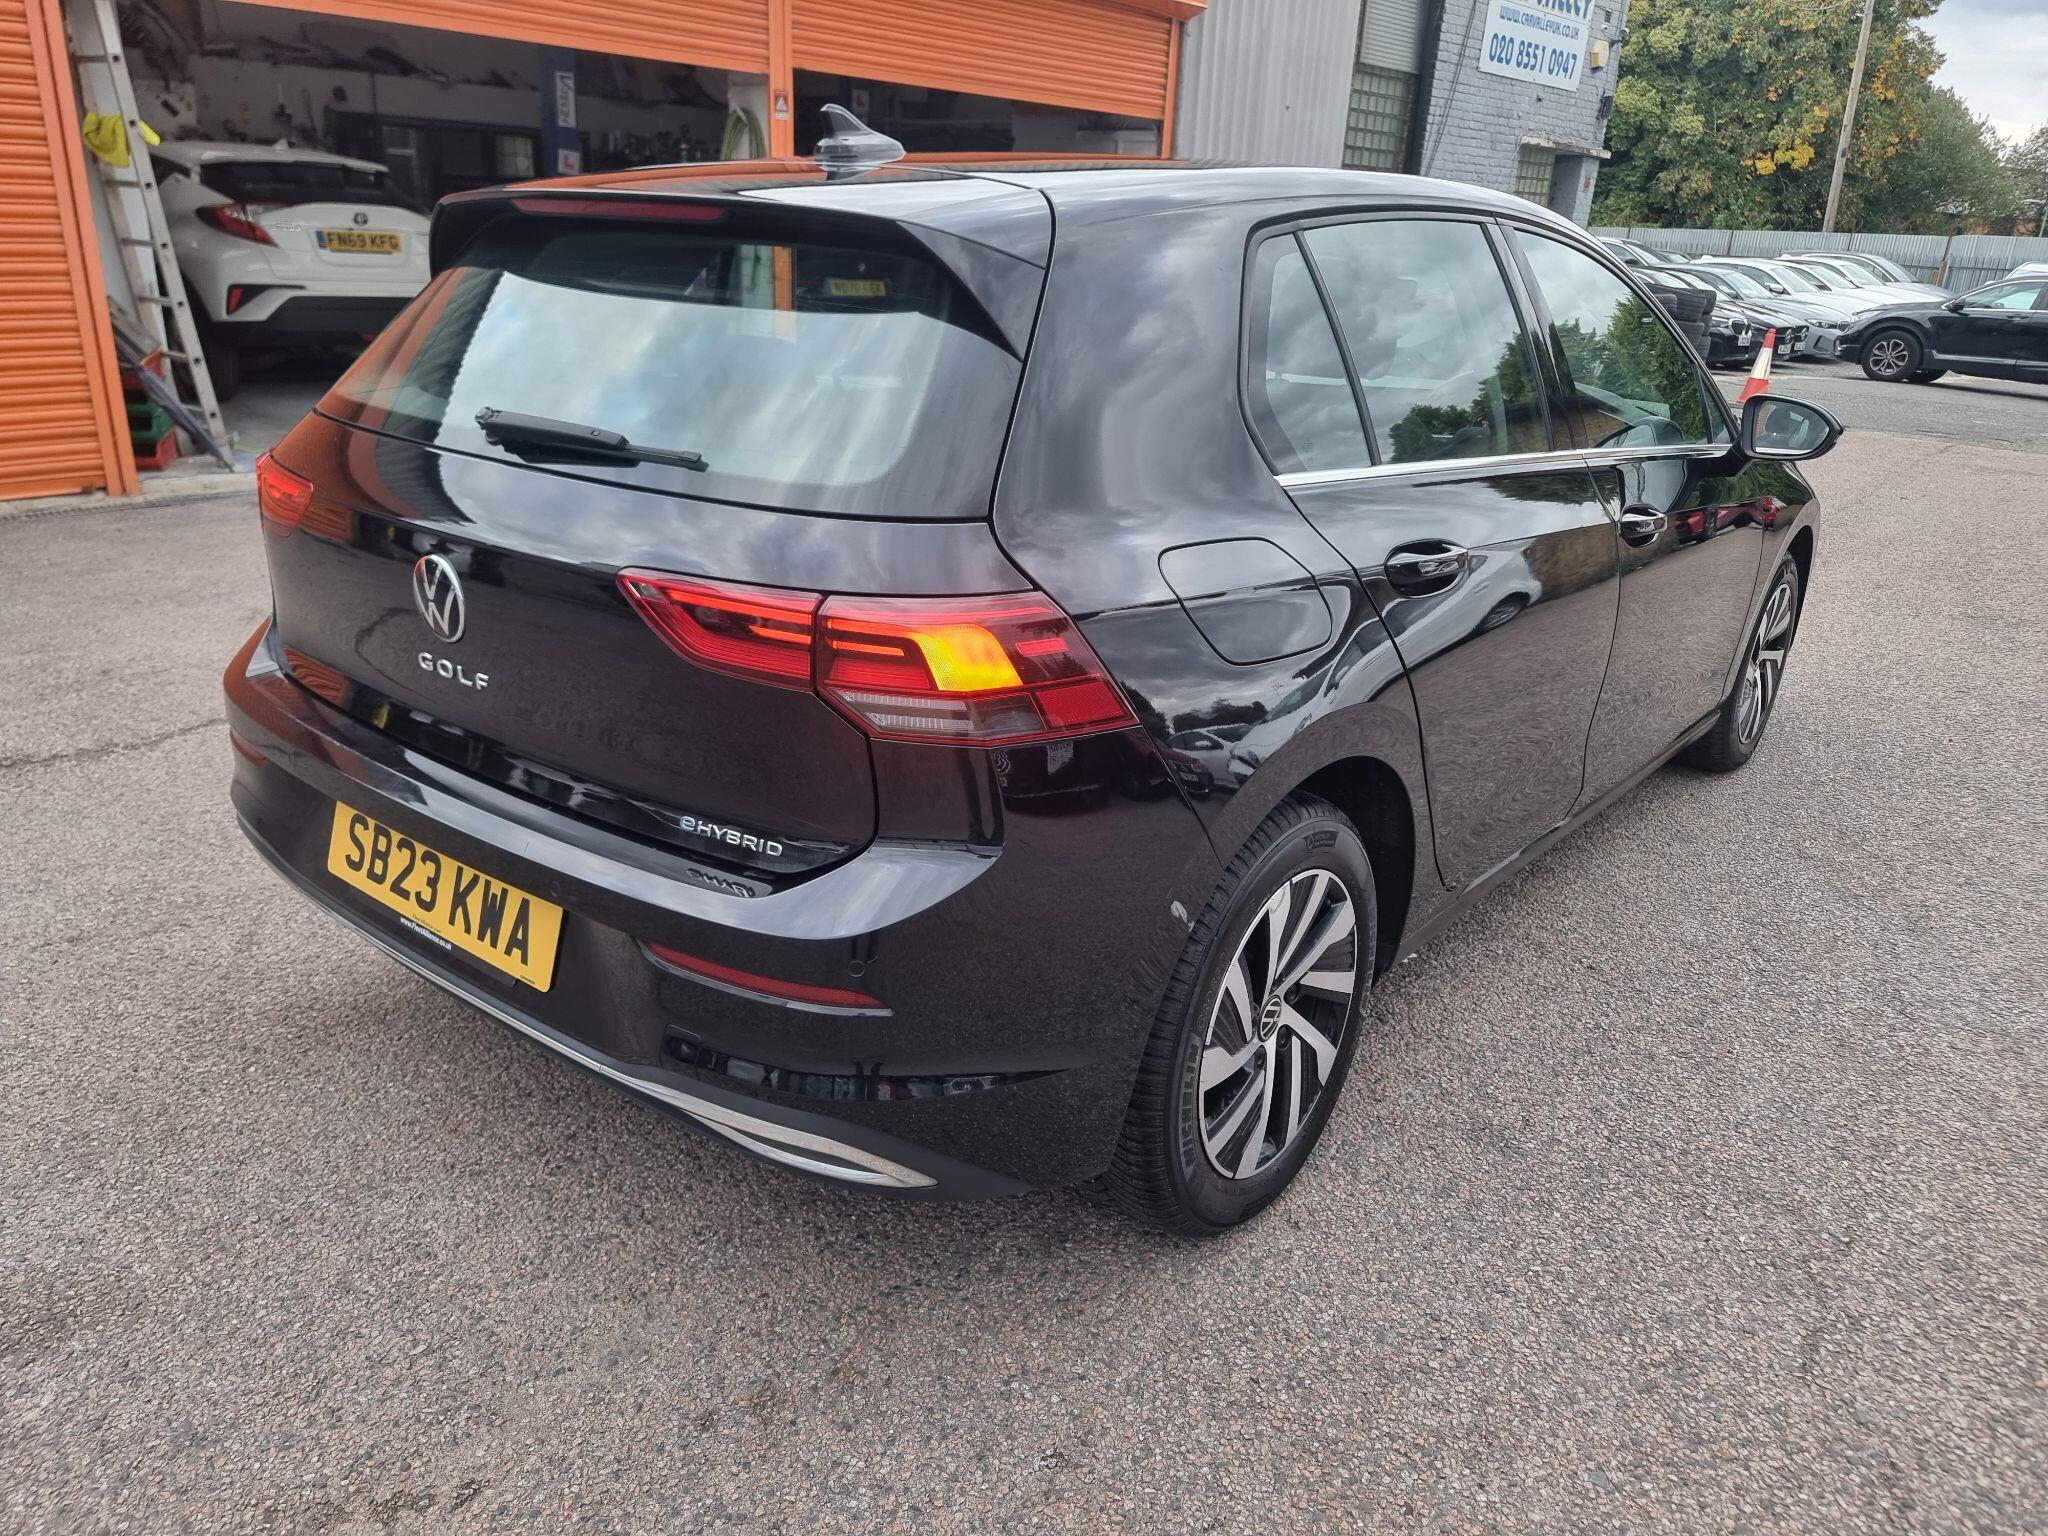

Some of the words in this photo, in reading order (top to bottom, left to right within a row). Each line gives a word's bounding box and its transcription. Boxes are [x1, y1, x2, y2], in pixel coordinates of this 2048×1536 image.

[1489, 32, 1515, 66] 020
[1515, 40, 1547, 73] 8551
[1547, 48, 1578, 80] 0947
[326, 231, 367, 249] FN69
[417, 651, 490, 690] GOLF
[345, 812, 442, 913] SB23
[448, 863, 532, 967] KWA
